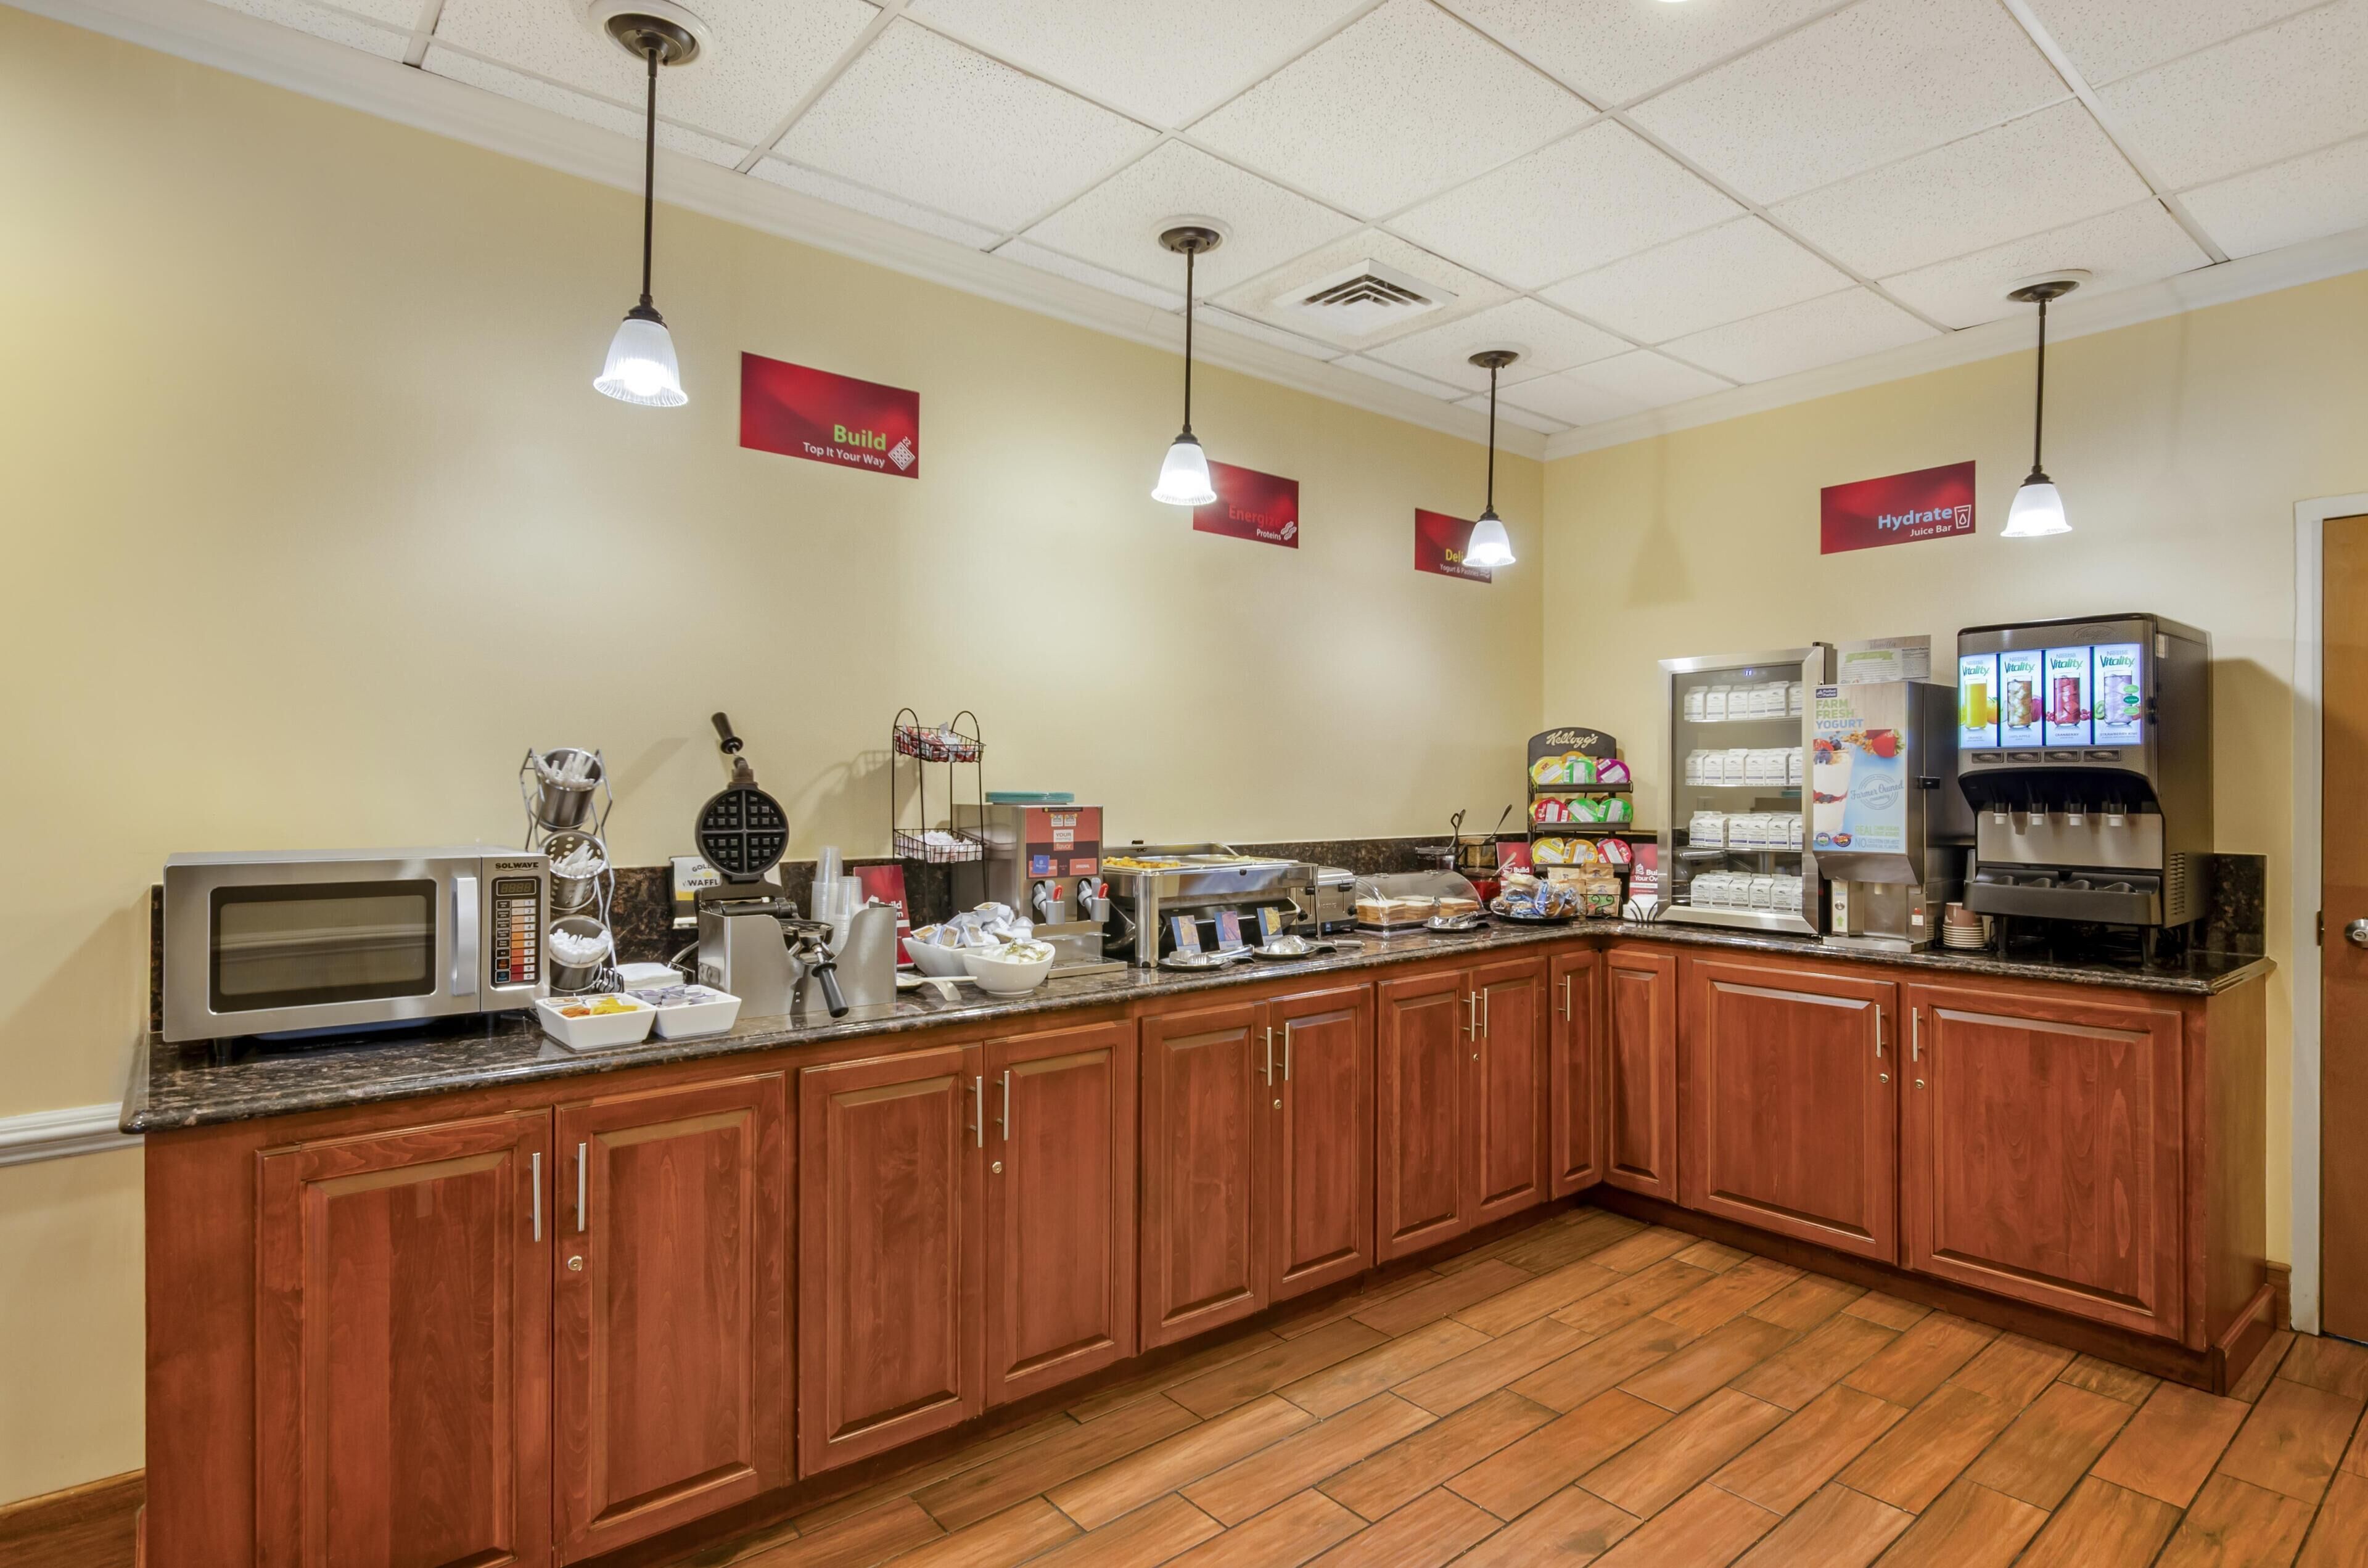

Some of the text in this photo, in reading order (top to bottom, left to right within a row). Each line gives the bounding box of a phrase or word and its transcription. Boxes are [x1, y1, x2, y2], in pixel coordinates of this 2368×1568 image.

[834, 424, 886, 451] Build
[803, 441, 886, 469] Top It Your Way
[1228, 504, 1282, 528] Energize
[1878, 507, 1953, 532] Hydrate
[1256, 528, 1281, 541] Proteins
[1910, 525, 1952, 537] Juice Bar
[1445, 548, 1464, 563] Deli
[1439, 563, 1456, 573] Yogurt
[2005, 661, 2036, 673] Vitality
[2050, 657, 2083, 670] Vitality
[2100, 654, 2135, 668] Vitality
[1962, 665, 1990, 676] Vitality
[1815, 699, 1848, 709] FARM
[1815, 708, 1855, 720] FRESH
[1815, 718, 1864, 729] YOGURT
[1545, 730, 1599, 749] Kellogg's
[1850, 779, 1904, 800] Farmer Owned
[1855, 838, 1867, 848] NO
